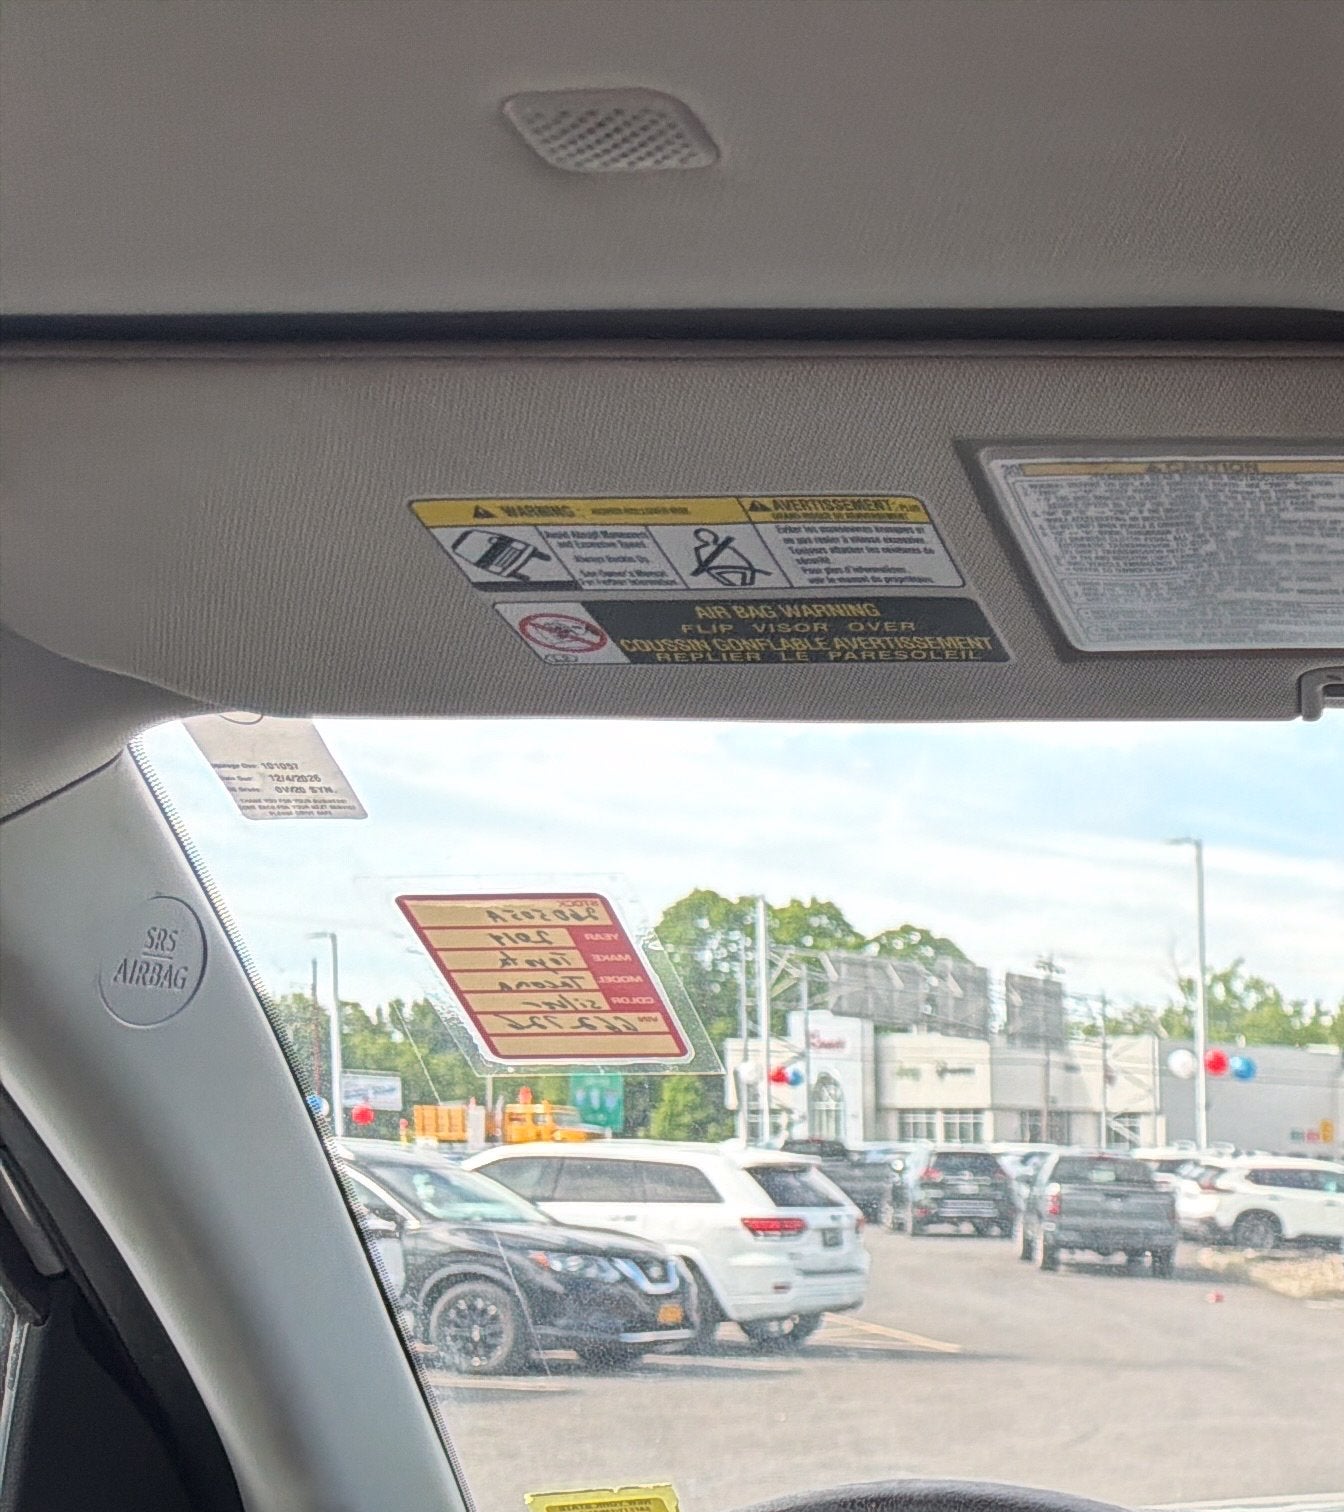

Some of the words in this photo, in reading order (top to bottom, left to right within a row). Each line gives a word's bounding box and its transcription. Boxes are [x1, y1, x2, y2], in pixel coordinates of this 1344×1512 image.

[695, 606, 730, 619] AIR
[735, 606, 776, 619] BAG
[781, 603, 880, 618] WARNING
[682, 623, 734, 633] FLIP
[754, 623, 829, 633] VISOR
[849, 622, 916, 632] OVER
[620, 639, 707, 652] COUSSIN
[834, 636, 990, 650] AVERTISSEMENT
[656, 652, 761, 662] REPLIER
[782, 652, 810, 661] LE
[829, 651, 982, 661] PARESOLEIL
[144, 926, 178, 952] SRS
[113, 958, 188, 989] AIRBAG
